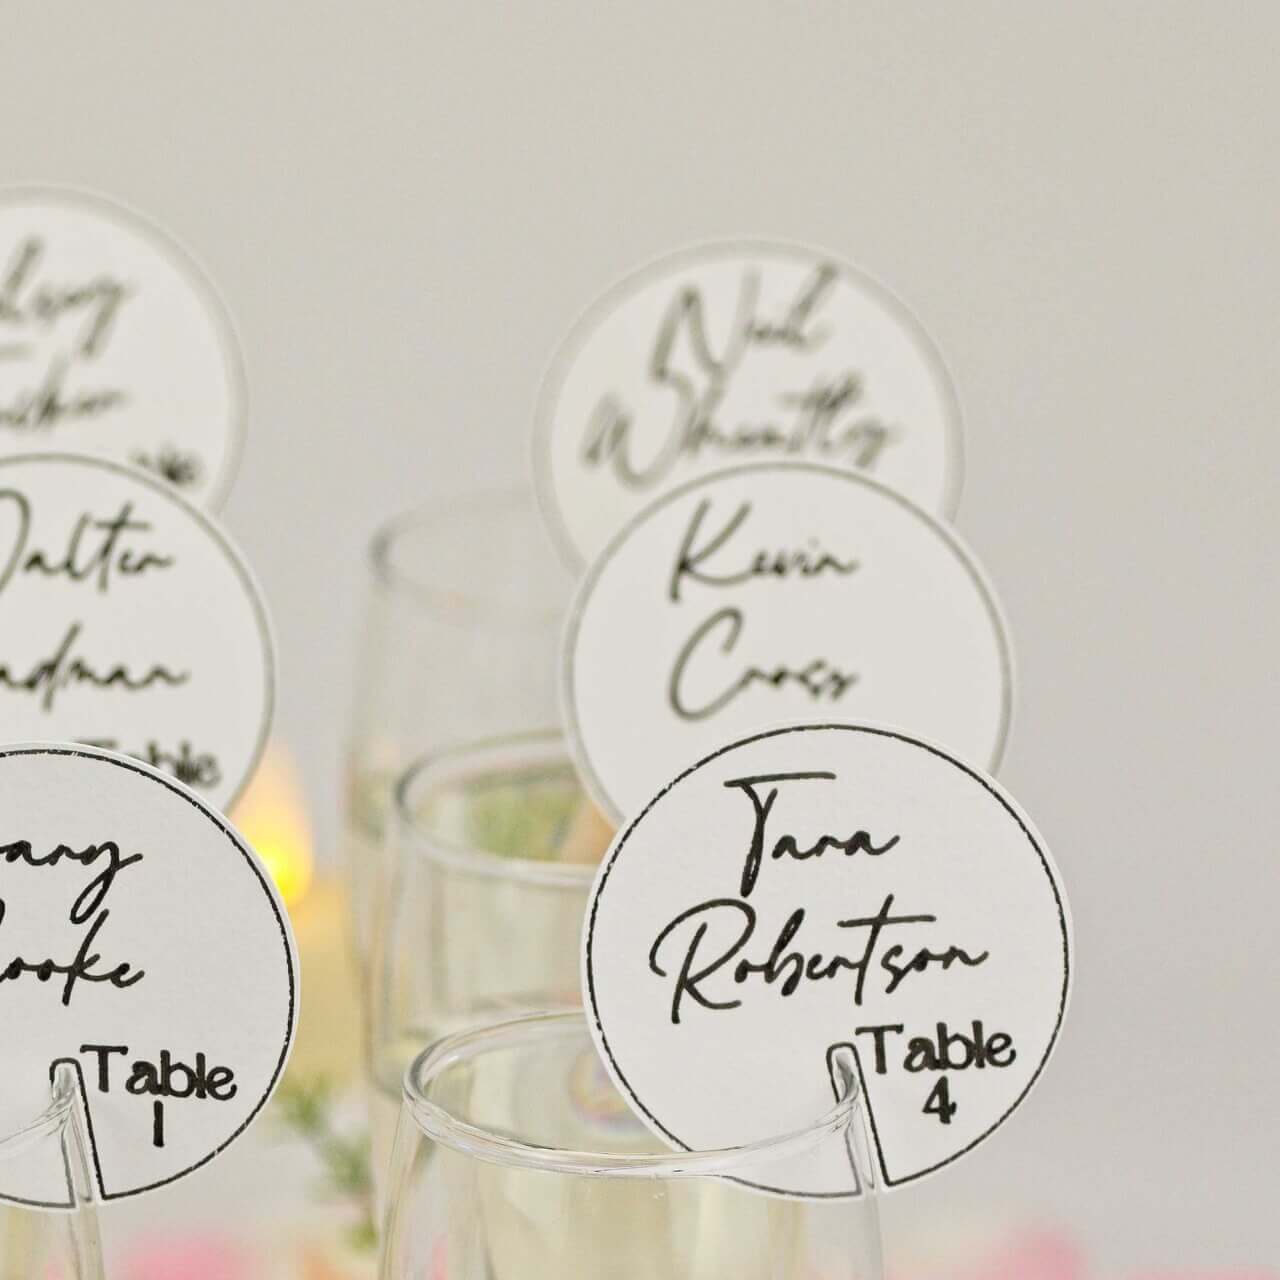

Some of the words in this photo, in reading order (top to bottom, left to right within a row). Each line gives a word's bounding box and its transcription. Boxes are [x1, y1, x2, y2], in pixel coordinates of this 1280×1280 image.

[669, 499, 861, 603] Kevin
[669, 606, 860, 722] Cross
[723, 772, 900, 898] Tara
[648, 894, 990, 1025] Robertson
[80, 1044, 238, 1101] Table
[855, 1020, 1017, 1075] Table
[922, 1075, 958, 1126] 4
